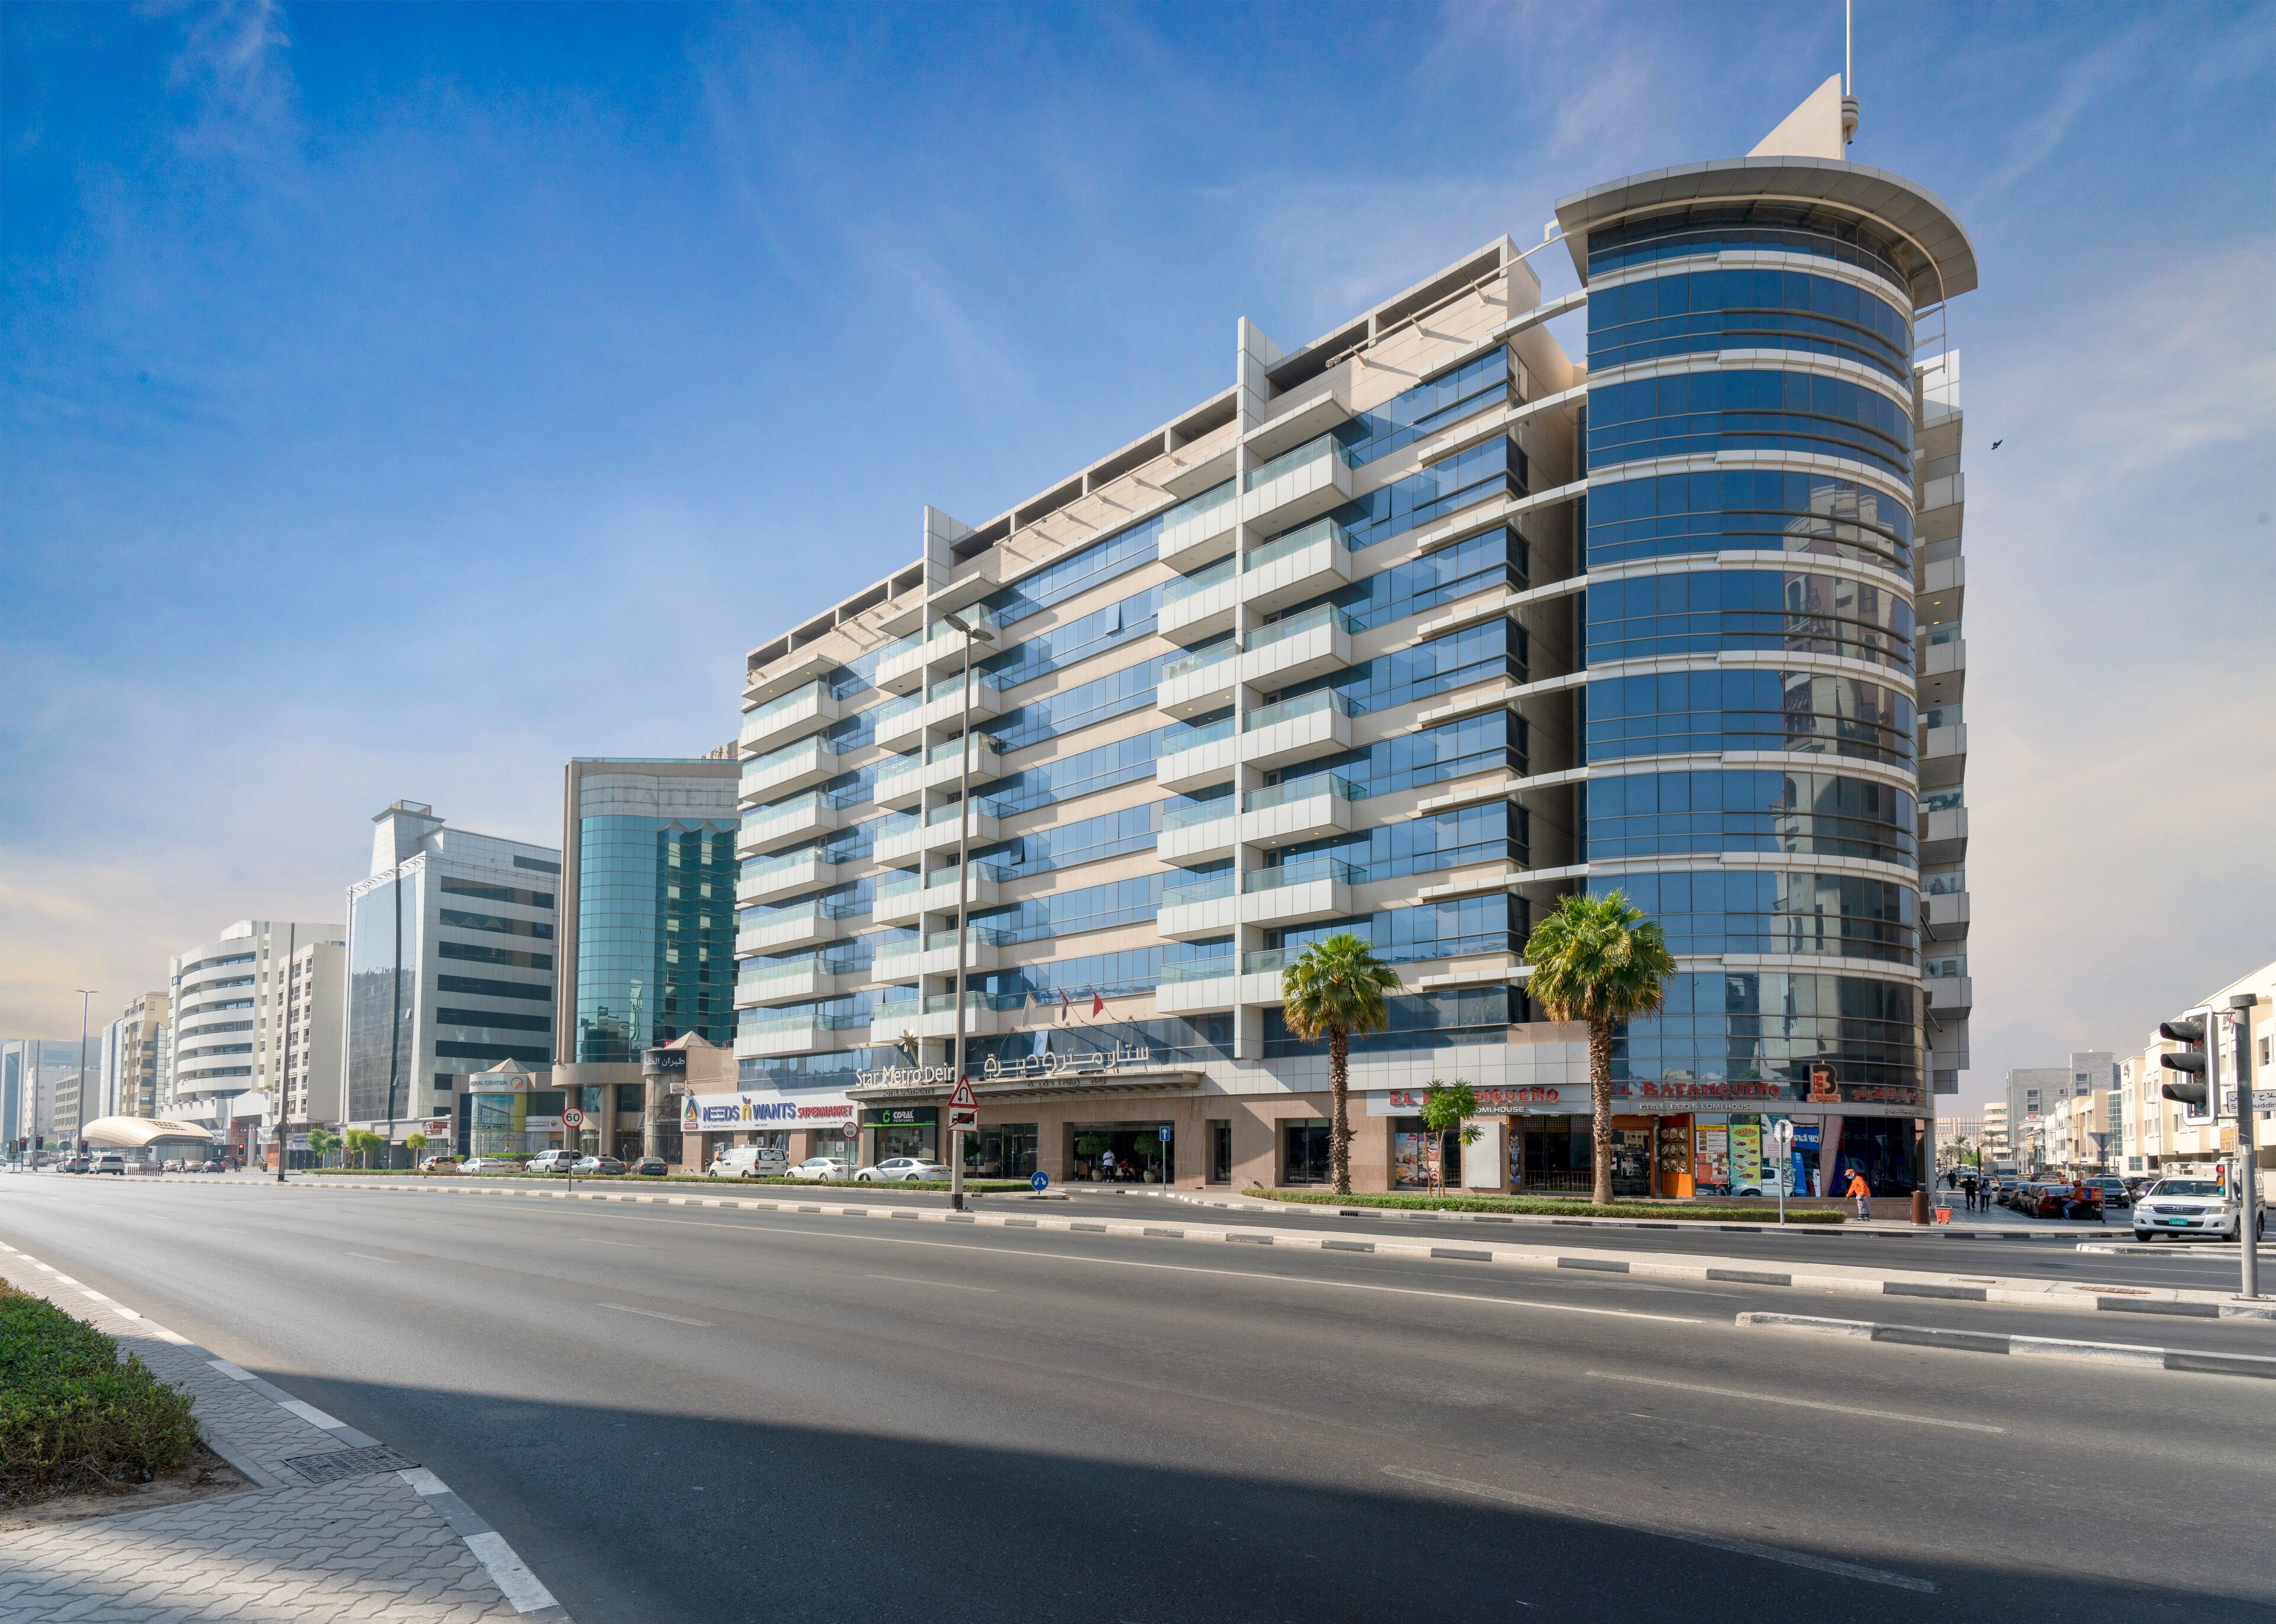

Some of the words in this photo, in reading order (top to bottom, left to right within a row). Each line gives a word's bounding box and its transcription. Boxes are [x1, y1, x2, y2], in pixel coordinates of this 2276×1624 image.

[1106, 1040, 1149, 1068] ستار
[661, 1057, 685, 1066] طيران
[1043, 1047, 1103, 1076] مترو
[856, 1068, 880, 1087] Star
[883, 1064, 921, 1085] Metro
[925, 1063, 954, 1083] Deir
[899, 1088, 934, 1096] APARTMENTS
[1422, 1086, 1559, 1104] NGUEÑO
[2259, 1092, 2276, 1101] لاح
[566, 1113, 580, 1121] 60
[702, 1105, 740, 1121] NEEDS
[753, 1102, 796, 1121] WANTS
[797, 1105, 853, 1118] SUPERMARKET
[893, 1111, 914, 1119] CORAL
